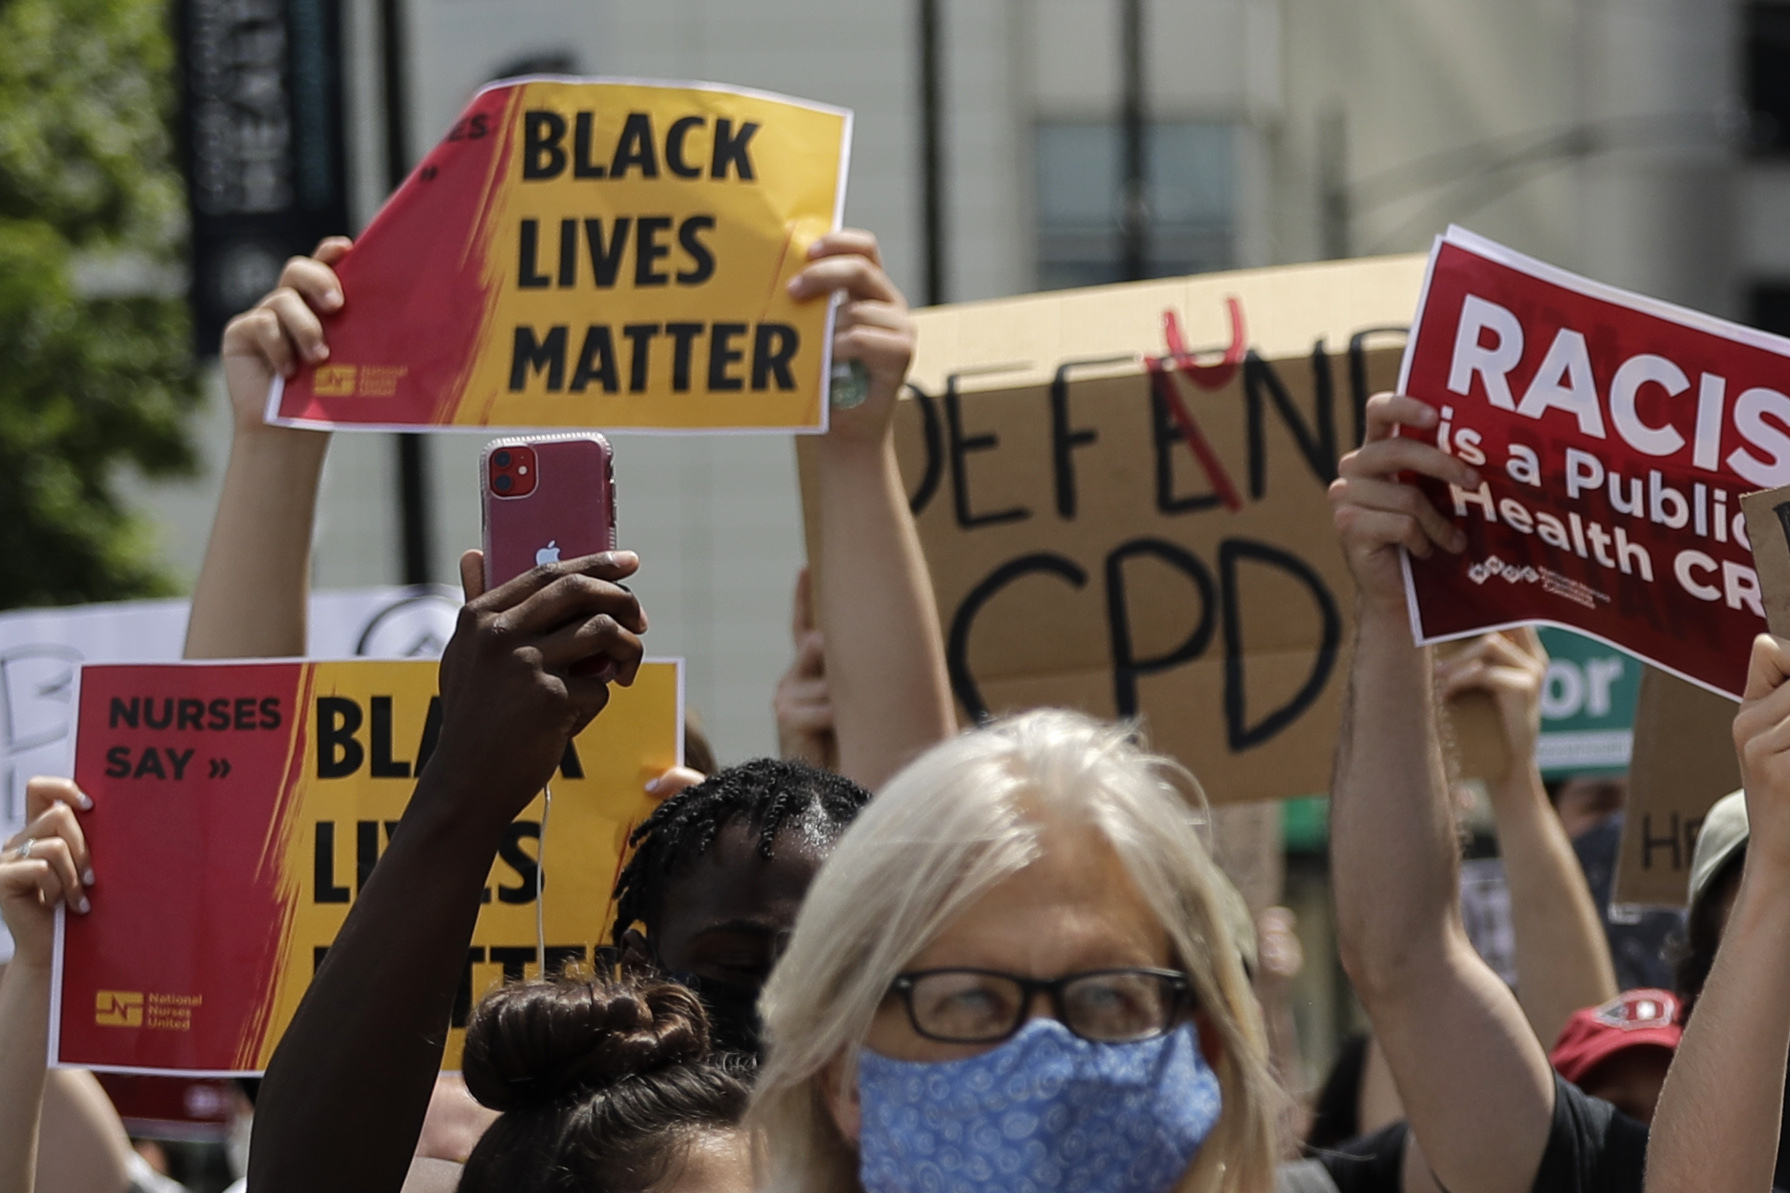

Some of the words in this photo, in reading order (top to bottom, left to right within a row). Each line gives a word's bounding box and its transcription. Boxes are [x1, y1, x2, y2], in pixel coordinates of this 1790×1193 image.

[521, 109, 762, 182] BLACK
[517, 214, 717, 290] LIVES
[508, 321, 800, 395] MATTER
[1437, 405, 1487, 466] is
[1506, 443, 1541, 487] a
[1450, 480, 1654, 583] Health
[948, 536, 1343, 752] CPD
[108, 696, 282, 731] NURSES
[105, 745, 195, 780] SAY
[149, 992, 203, 1006] National
